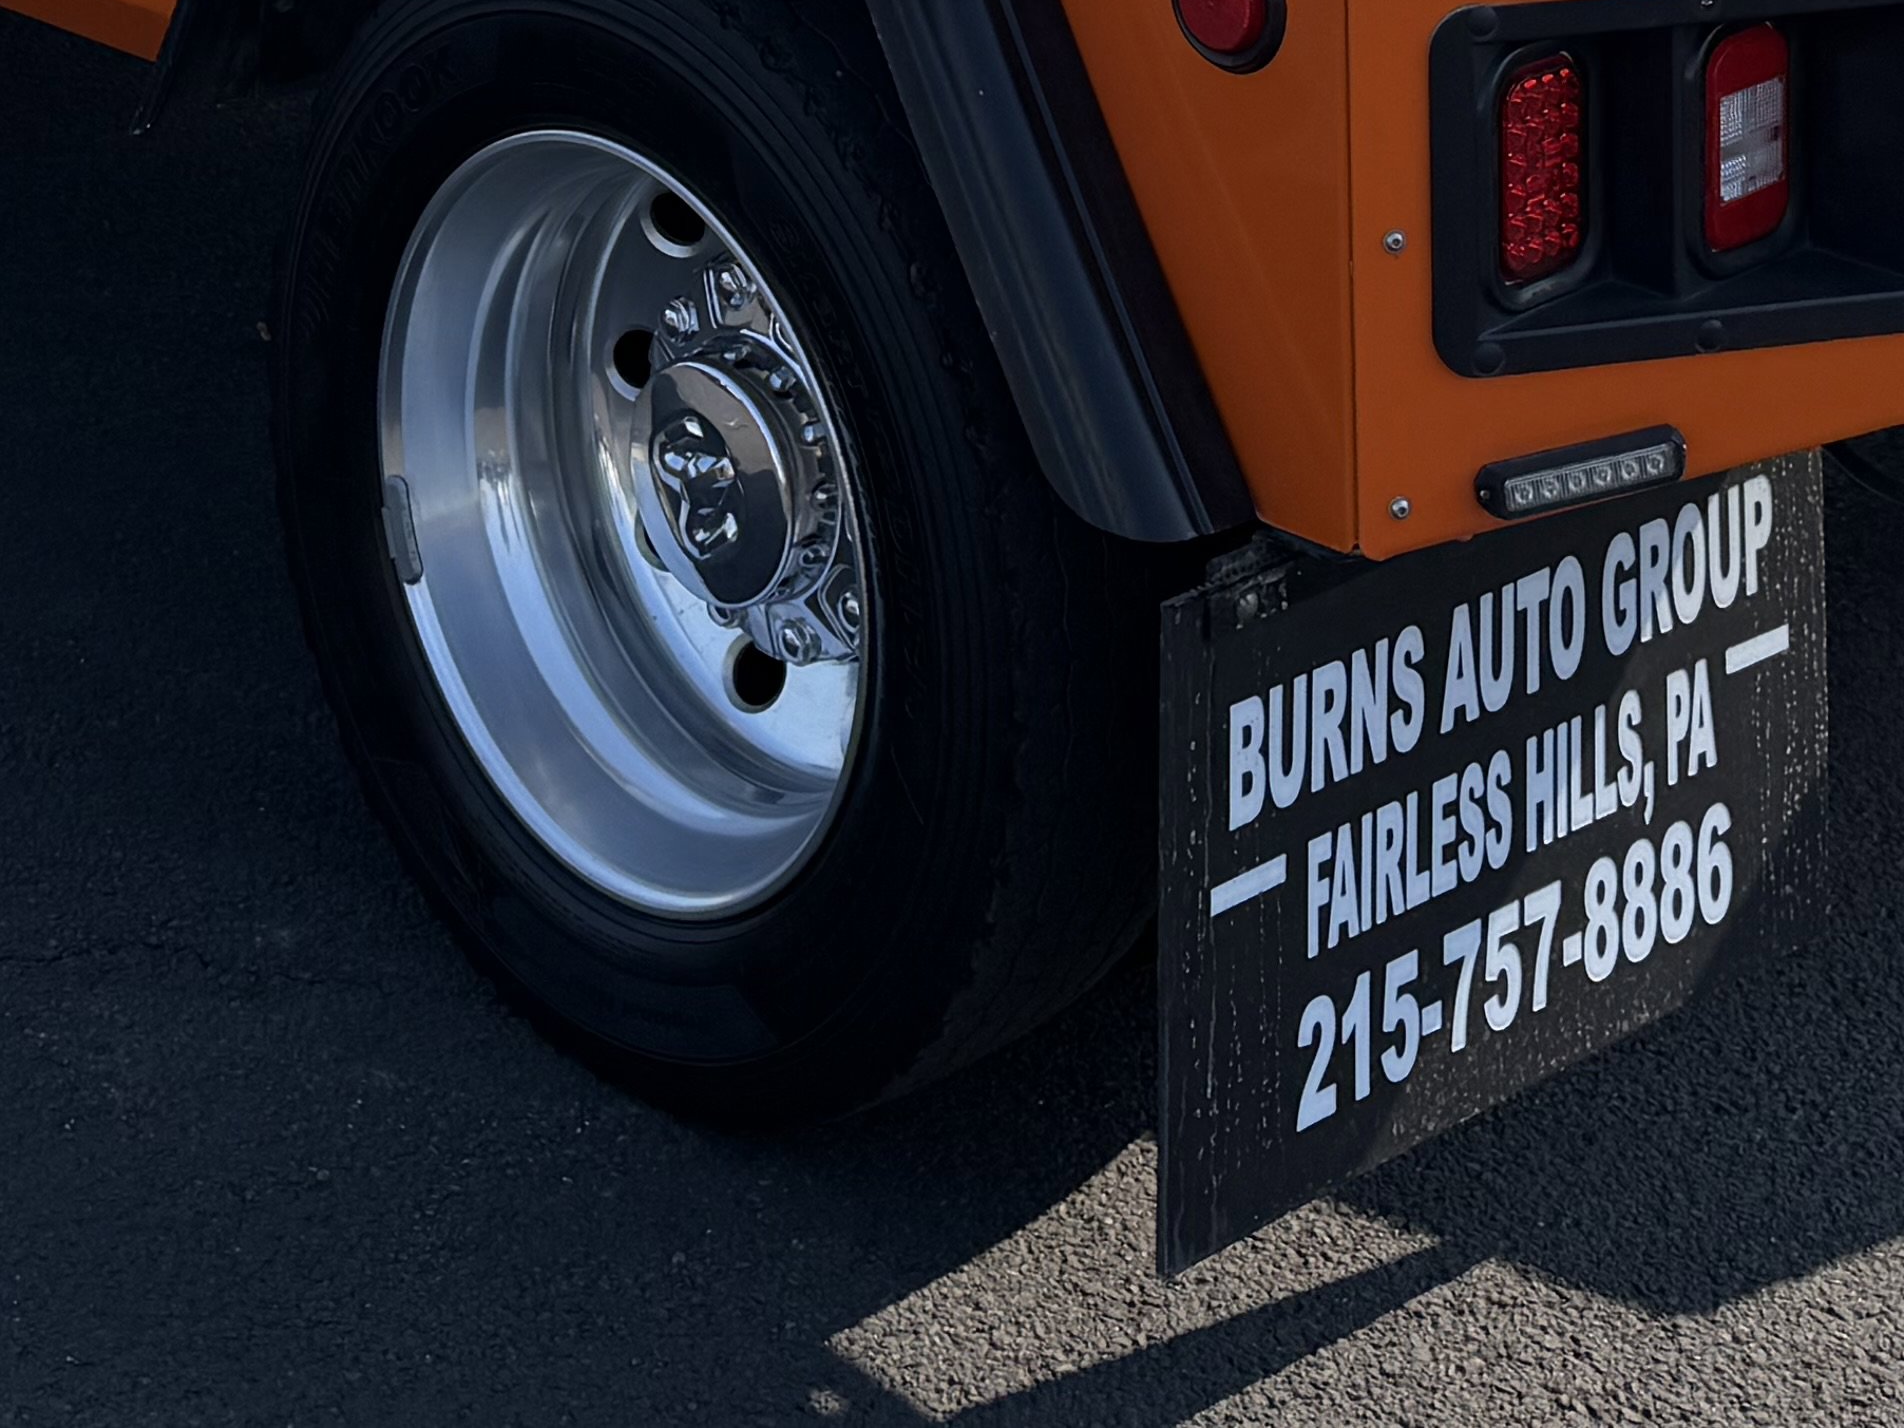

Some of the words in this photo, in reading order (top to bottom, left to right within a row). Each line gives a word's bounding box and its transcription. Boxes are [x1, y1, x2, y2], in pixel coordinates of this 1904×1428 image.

[1229, 625, 1425, 831] BURNS
[1440, 556, 1585, 734] AUTO
[1603, 475, 1773, 656] GROUP
[1307, 750, 1512, 958] FAIRLESS
[1526, 690, 1655, 853] HILLS,
[1667, 658, 1717, 785] PA
[1296, 803, 1733, 1132] 215-757-8886
